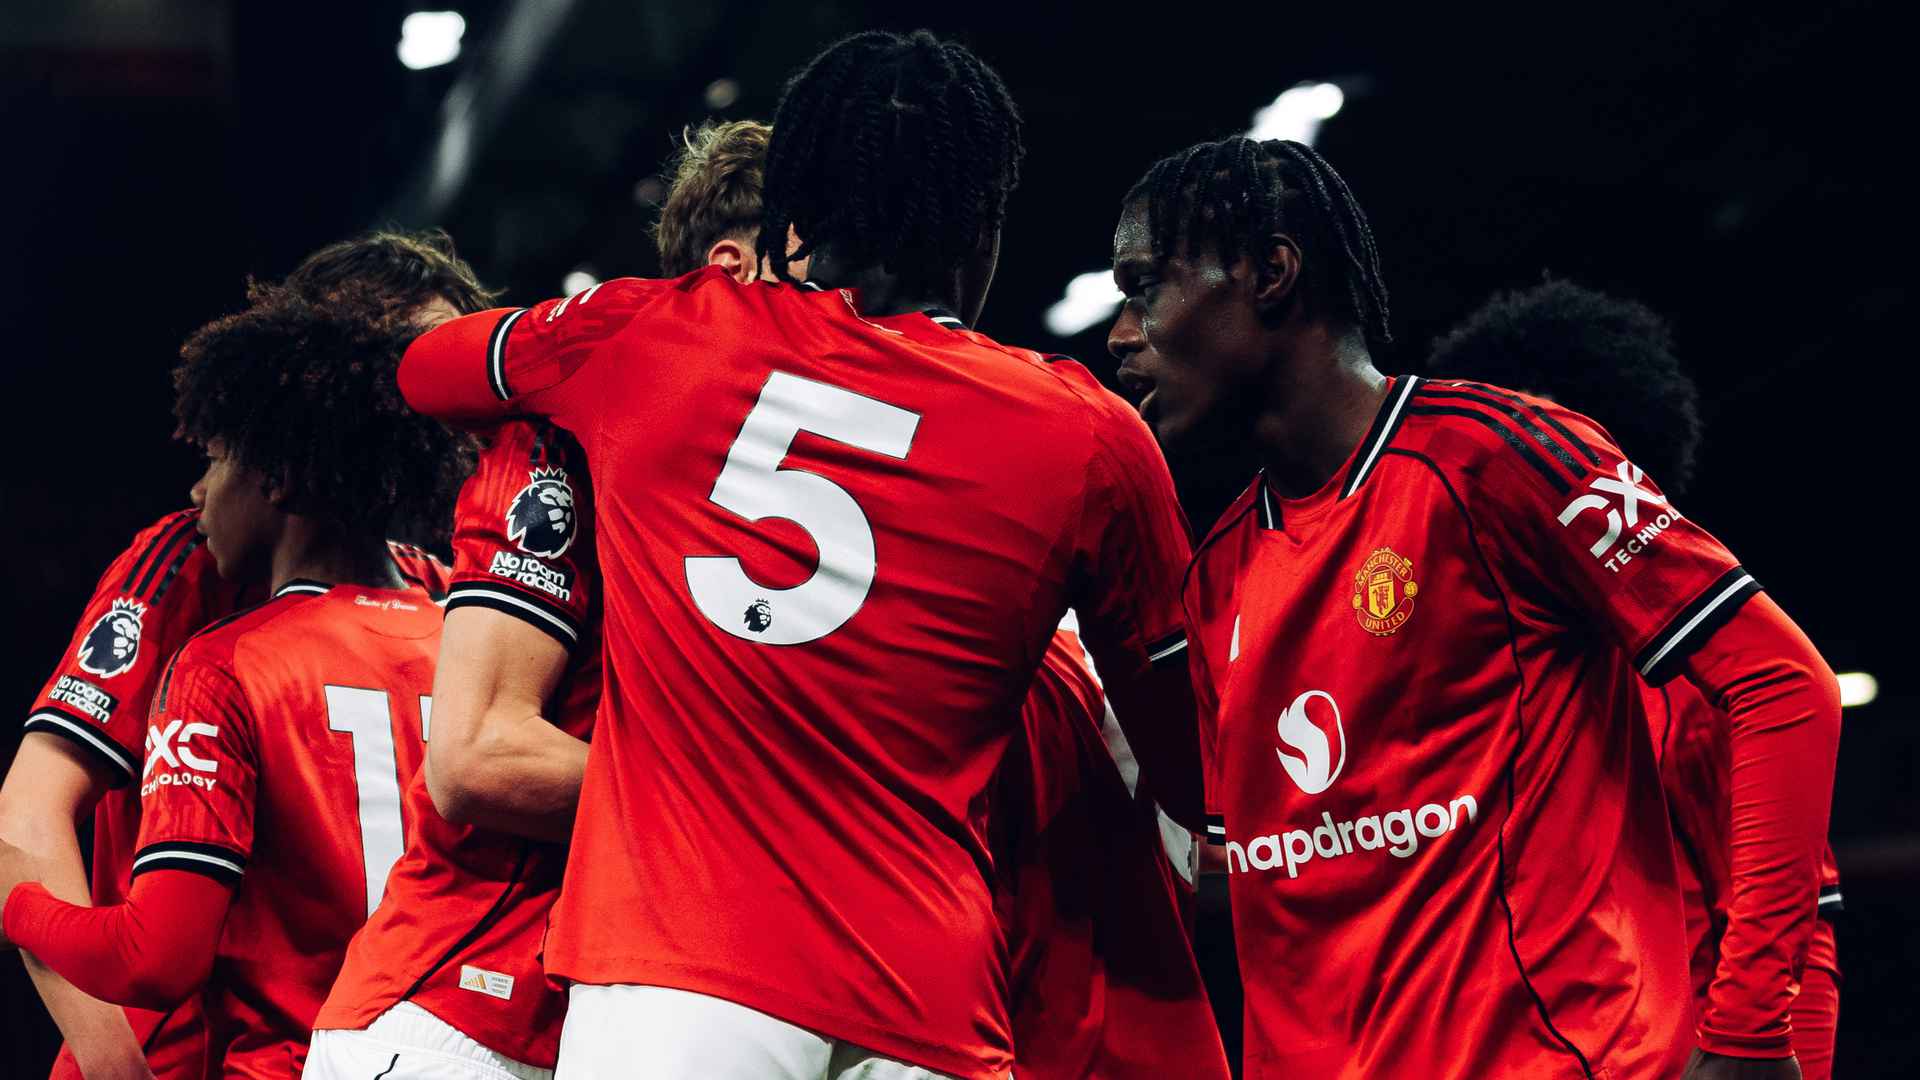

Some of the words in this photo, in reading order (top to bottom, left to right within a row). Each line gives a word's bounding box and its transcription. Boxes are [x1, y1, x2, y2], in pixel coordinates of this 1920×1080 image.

[684, 370, 923, 646] 5
[1557, 460, 1667, 559] DX
[1604, 508, 1681, 574] TECHNOL
[489, 564, 516, 578] for
[516, 572, 570, 601] racism
[493, 551, 520, 569] No
[521, 558, 565, 586] room
[1359, 554, 1409, 585] MANCHESTER
[1365, 611, 1406, 630] UNITED
[69, 680, 111, 708] room
[143, 720, 218, 777] XC
[141, 772, 217, 796] CHNOLOGY
[1226, 795, 1478, 878] napdragon
